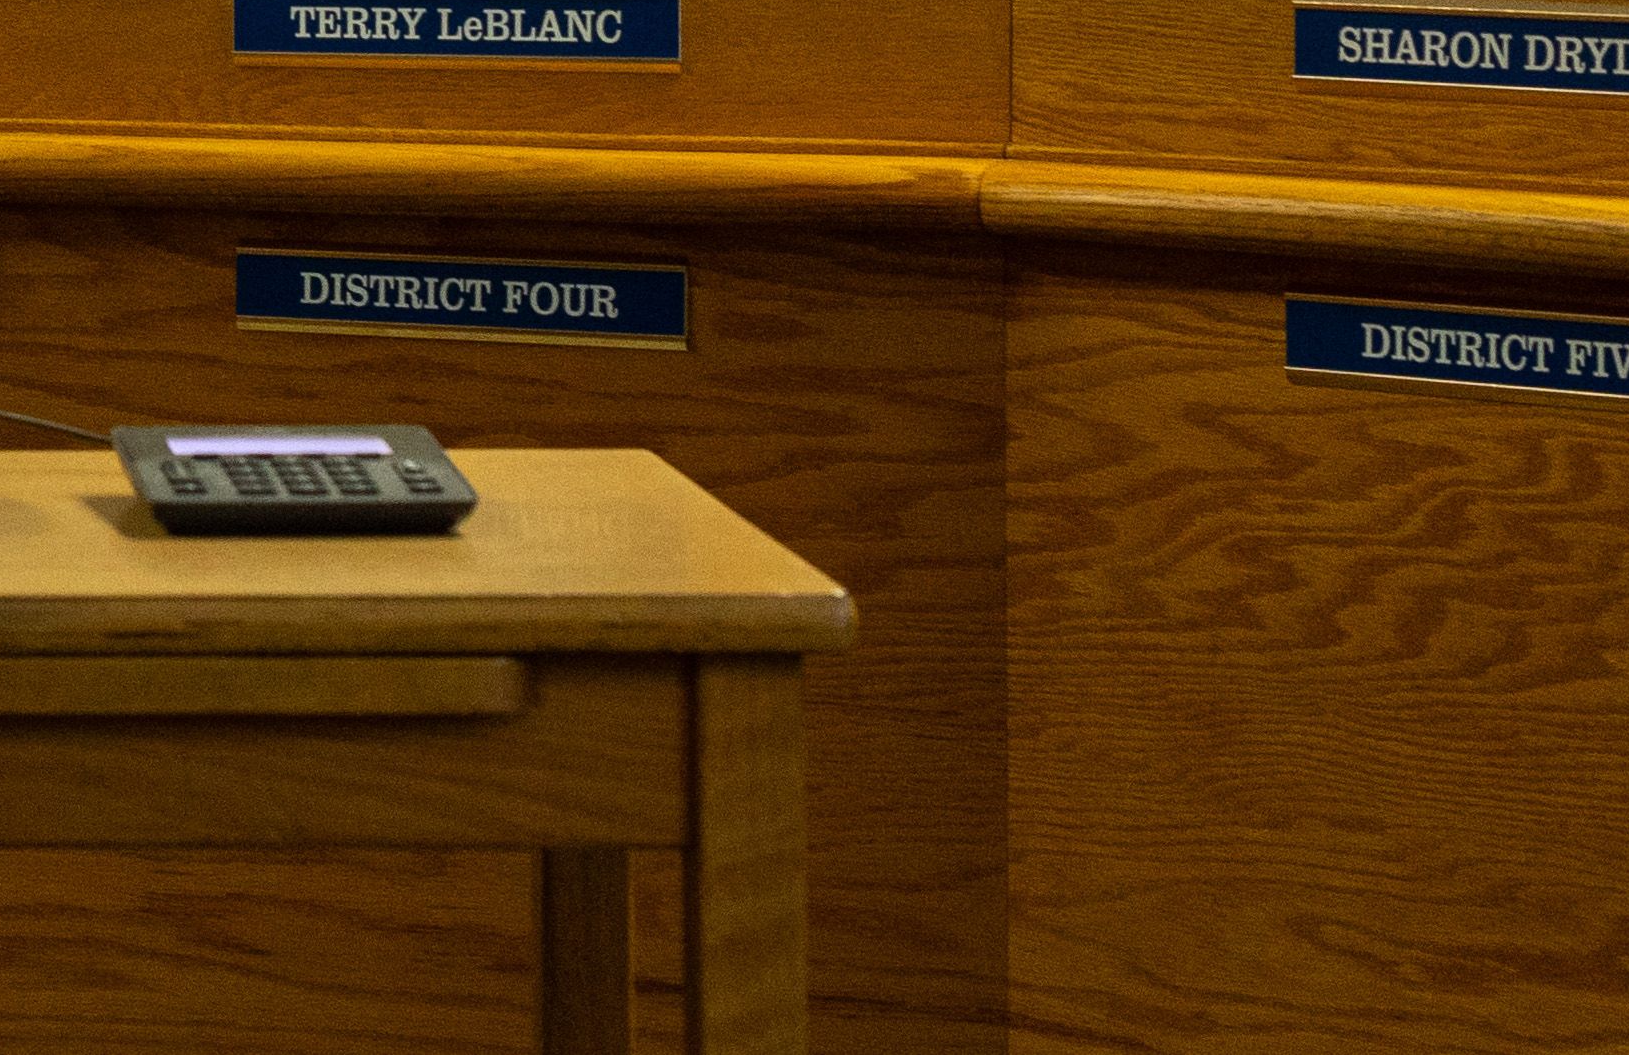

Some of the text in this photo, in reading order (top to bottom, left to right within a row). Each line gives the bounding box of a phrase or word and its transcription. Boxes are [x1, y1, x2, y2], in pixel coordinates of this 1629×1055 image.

[290, 5, 623, 44] TERRY LeBLANC
[1338, 25, 1513, 70] SHARON
[300, 272, 620, 319] DISTRICT FOUR
[1361, 322, 1554, 373] DISTRICT
